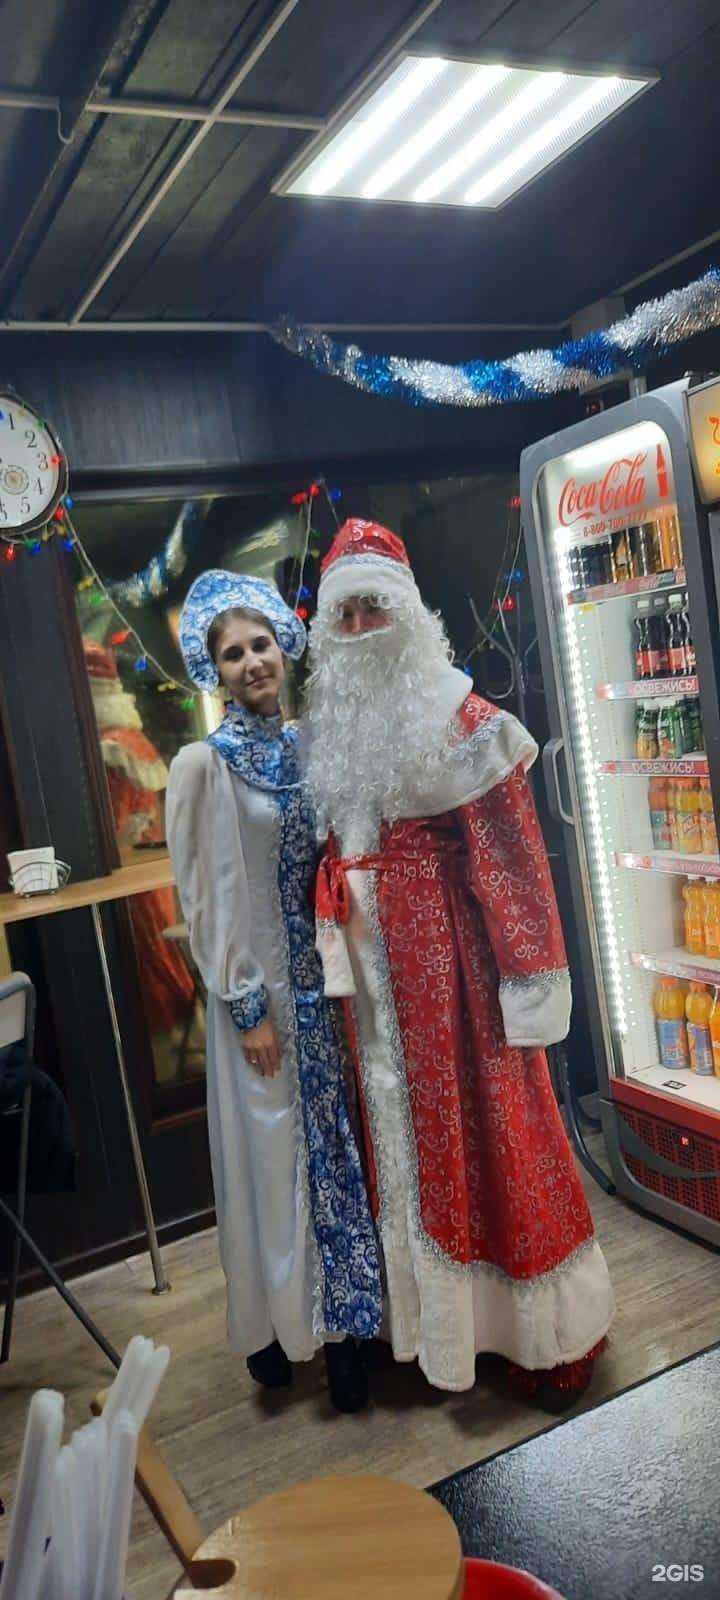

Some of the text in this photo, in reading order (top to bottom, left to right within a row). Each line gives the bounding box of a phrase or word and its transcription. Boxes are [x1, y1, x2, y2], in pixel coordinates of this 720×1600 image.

[8, 413, 15, 431] 1
[24, 430, 38, 449] 2
[37, 452, 49, 472] 3
[33, 477, 45, 496] 4
[20, 496, 31, 514] 5
